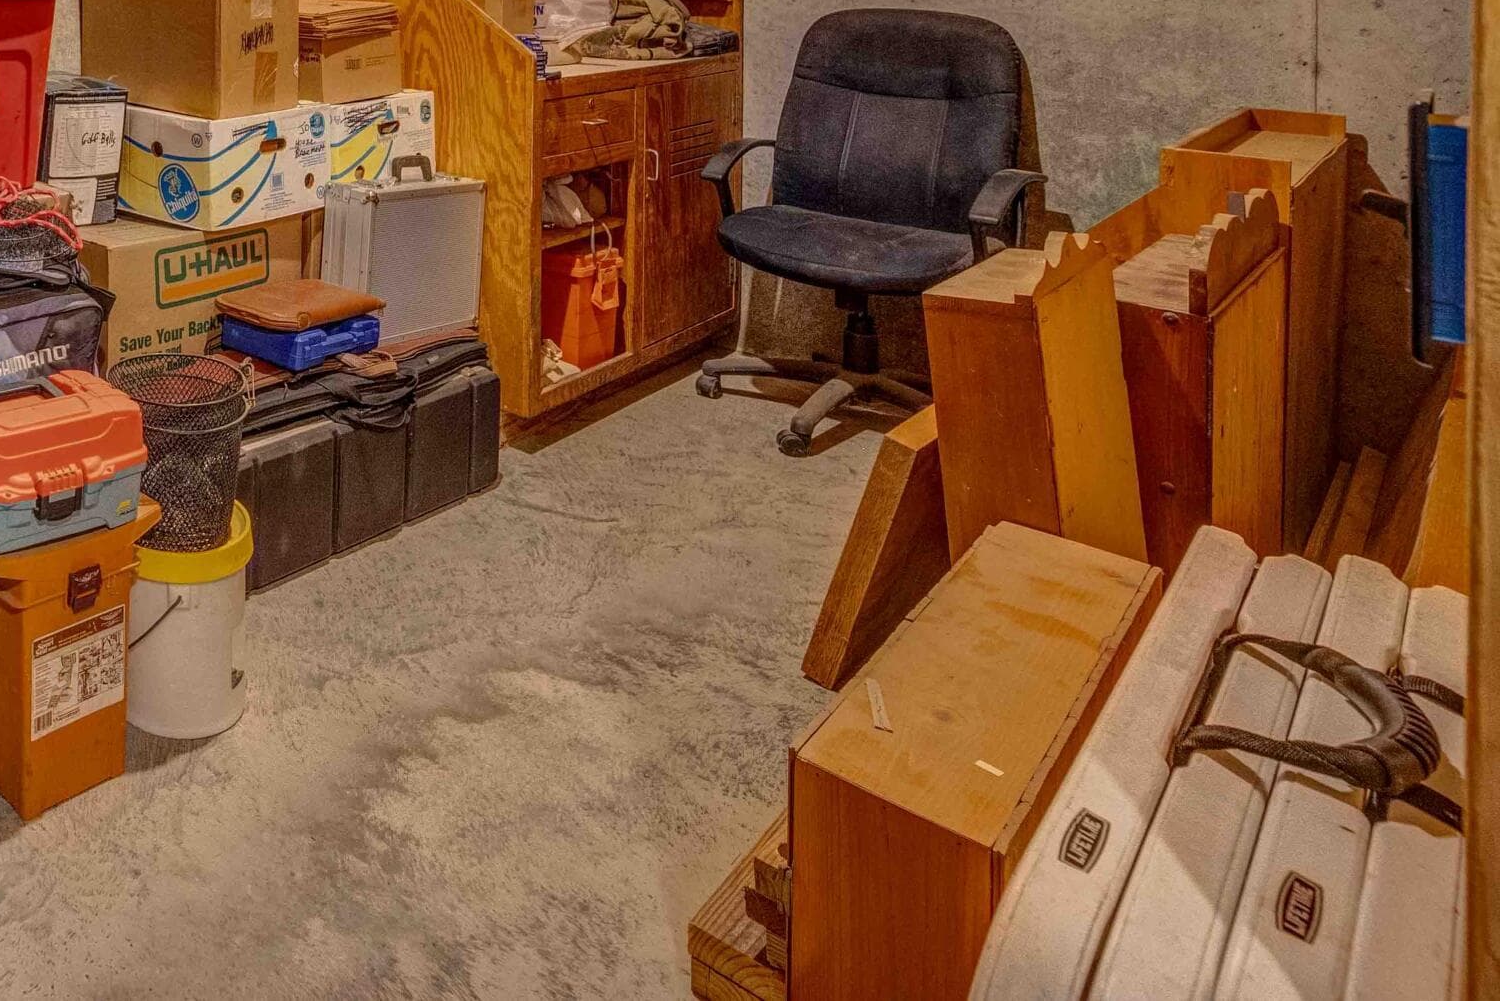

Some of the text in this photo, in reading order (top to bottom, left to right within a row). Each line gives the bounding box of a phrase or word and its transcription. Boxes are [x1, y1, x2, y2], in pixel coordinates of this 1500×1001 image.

[163, 239, 263, 284] U-HAUL
[119, 335, 152, 353] Save
[156, 326, 185, 344] Your
